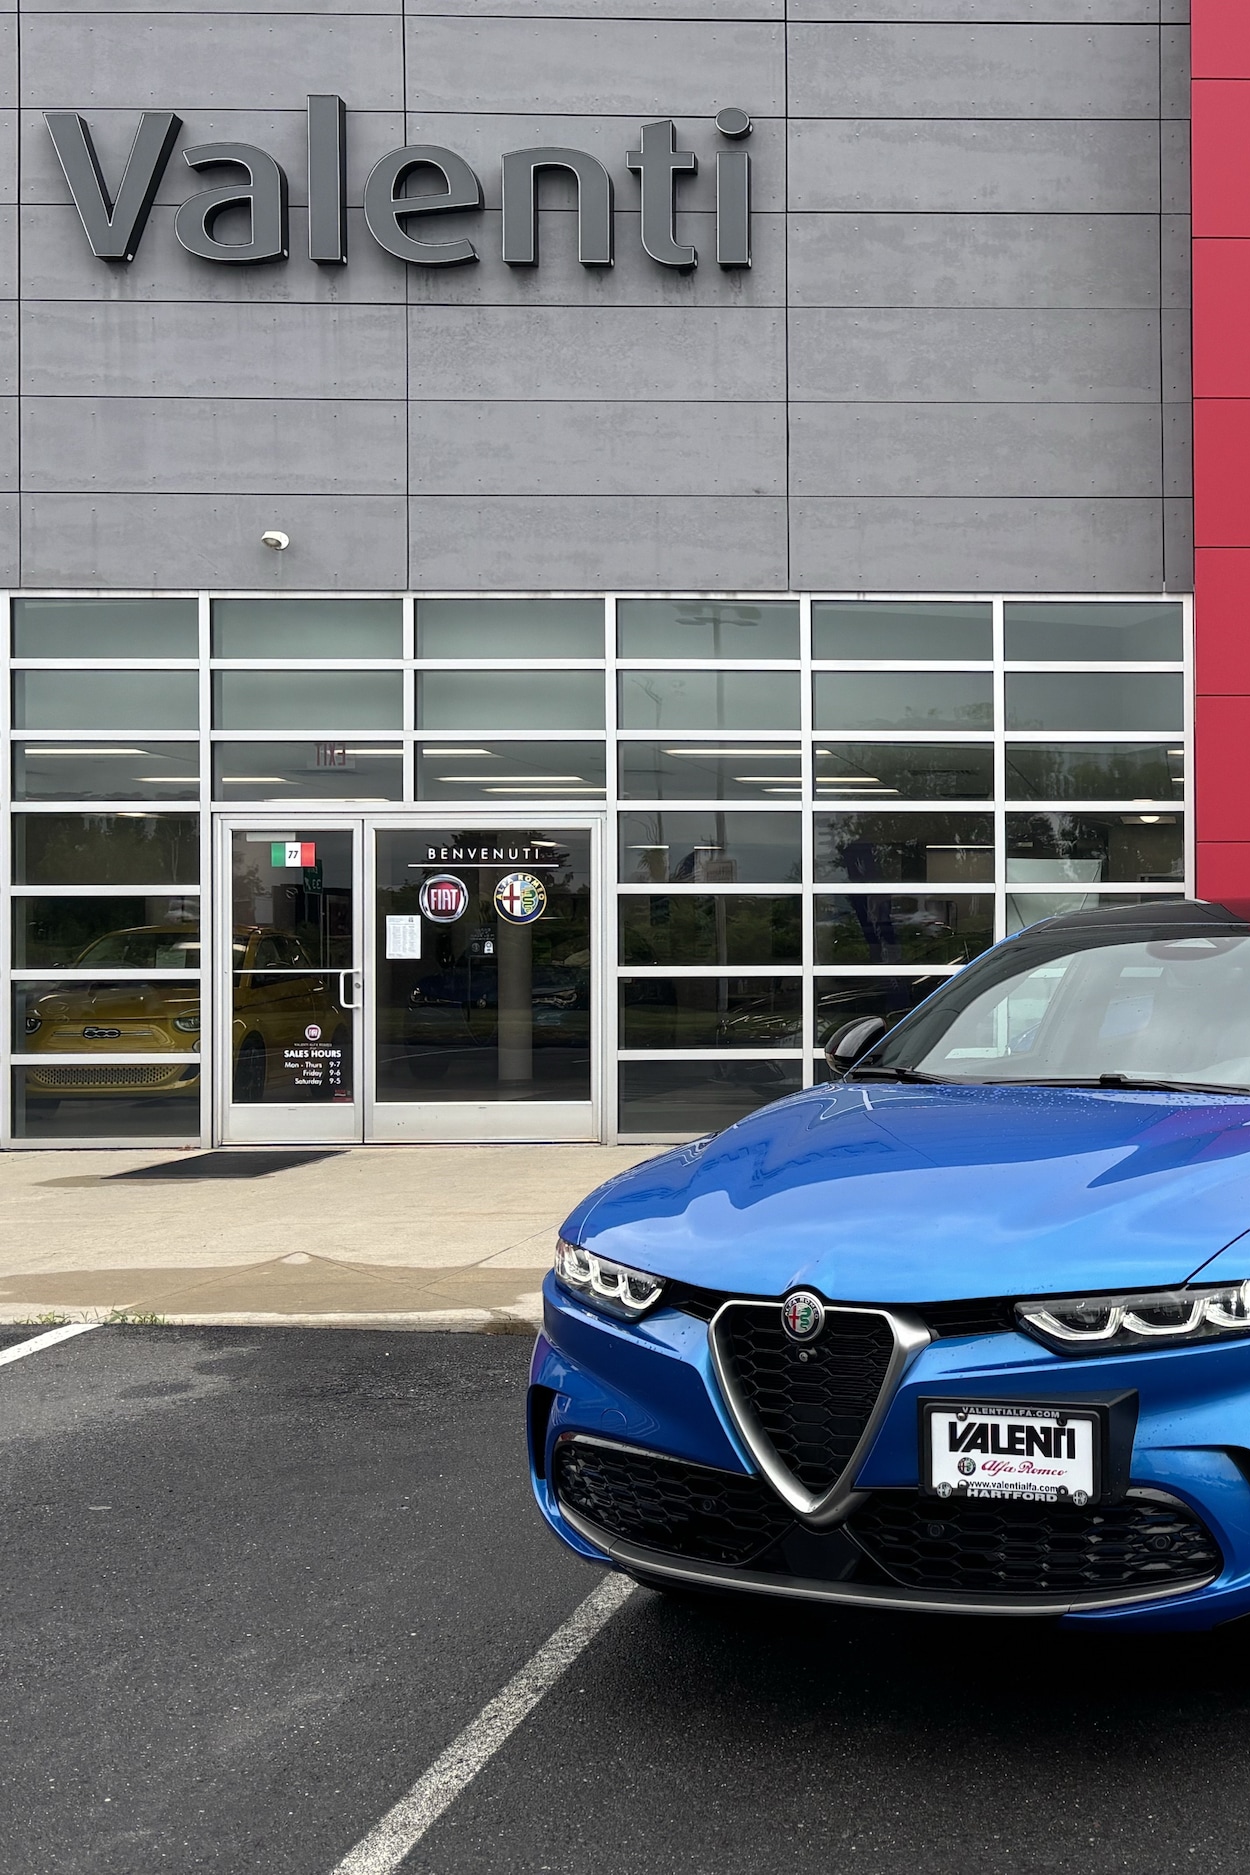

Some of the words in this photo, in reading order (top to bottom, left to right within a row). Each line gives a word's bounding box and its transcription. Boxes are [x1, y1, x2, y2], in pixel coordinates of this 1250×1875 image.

[42, 94, 754, 269] Valenti
[287, 850, 299, 859] 77
[427, 847, 540, 860] BENVENUTI
[517, 874, 545, 901] ROMEO
[430, 888, 459, 911] FIAT
[284, 1049, 309, 1058] SALES
[311, 1049, 341, 1058] HOURS
[295, 1078, 322, 1086] Saturday
[962, 1406, 1060, 1419] VALENTIALFA.COM
[948, 1421, 1076, 1460] VALENTI
[981, 1459, 1017, 1477] Alfa
[1017, 1460, 1067, 1477] Romeo
[966, 1488, 1058, 1503] HARTFORD
